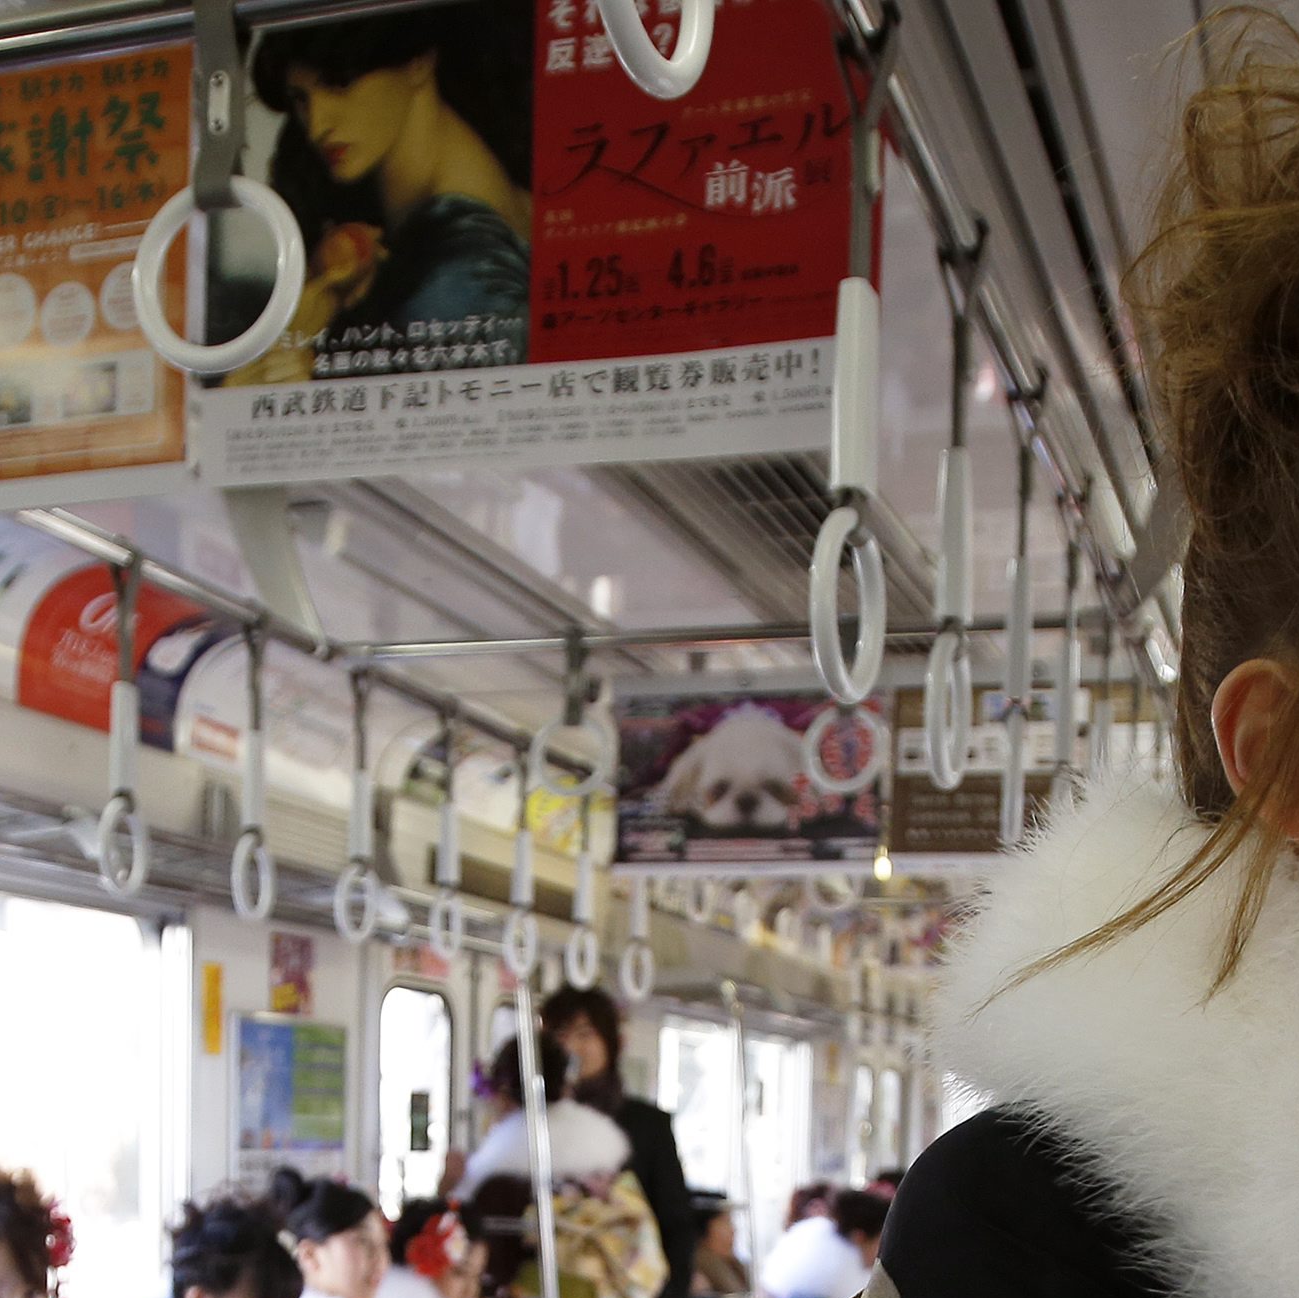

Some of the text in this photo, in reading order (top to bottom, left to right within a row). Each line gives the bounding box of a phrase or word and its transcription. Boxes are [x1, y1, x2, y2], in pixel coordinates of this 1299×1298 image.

[541, 102, 851, 196] ラファエル
